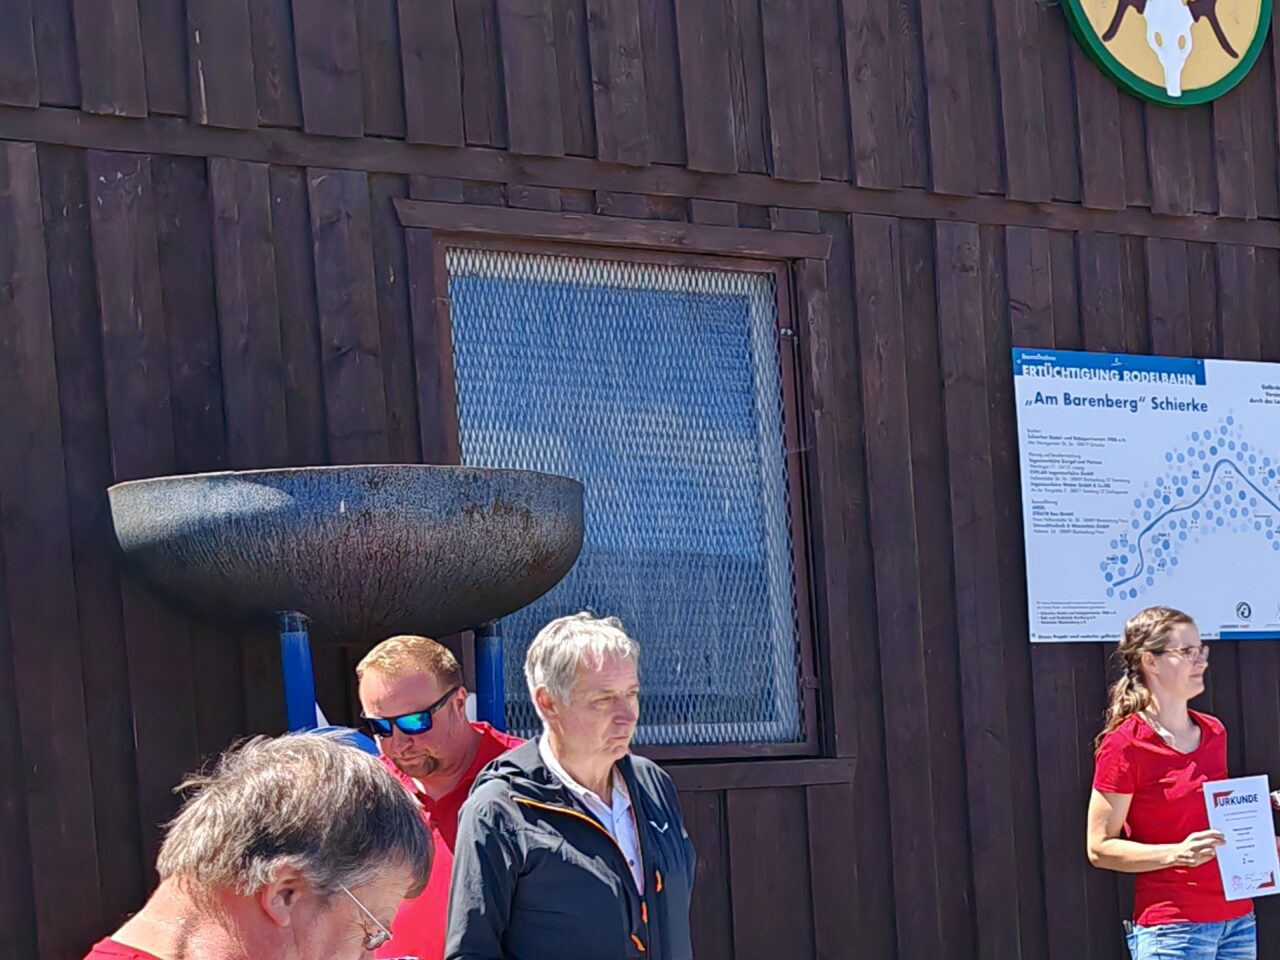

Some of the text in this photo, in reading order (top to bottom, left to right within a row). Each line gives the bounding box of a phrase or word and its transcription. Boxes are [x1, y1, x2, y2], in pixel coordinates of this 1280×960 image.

[1022, 362, 1196, 386] ERTÜCHTIGUNG RODELBAHN
[1151, 396, 1208, 412] Schierke
[1218, 793, 1258, 807] URKUNDE
